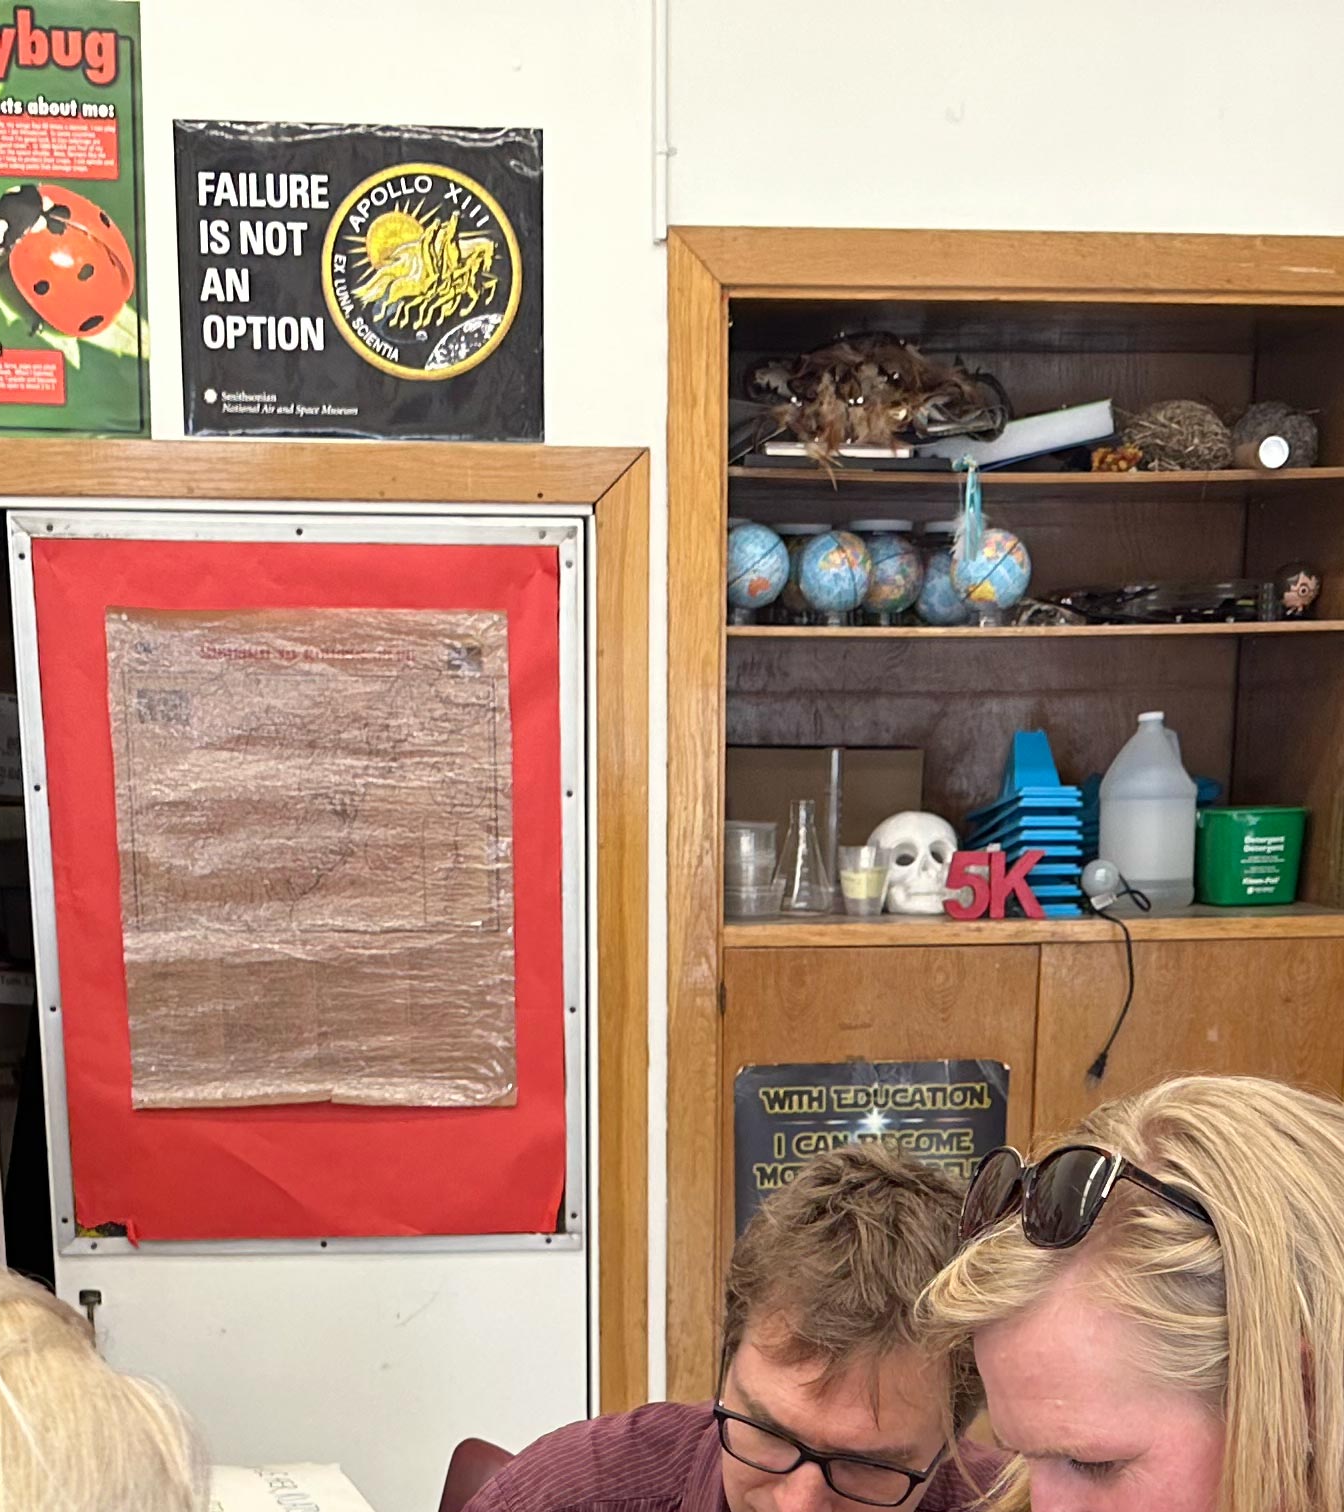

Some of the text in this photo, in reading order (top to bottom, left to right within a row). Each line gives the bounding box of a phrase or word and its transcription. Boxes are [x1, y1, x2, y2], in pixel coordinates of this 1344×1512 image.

[27, 95, 78, 117] about
[81, 103, 116, 118] me:
[197, 171, 330, 210] FAILURE
[347, 174, 491, 234] APOLLO XIII
[199, 219, 309, 257] IS NOT
[200, 267, 250, 303] AN
[333, 252, 400, 363] EX LUNA, SCIENTIA
[202, 314, 325, 351] OPTION
[276, 402, 294, 414] and
[942, 849, 1046, 920] 5K
[759, 1086, 826, 1114] WITH
[774, 1132, 850, 1158] I CAN
